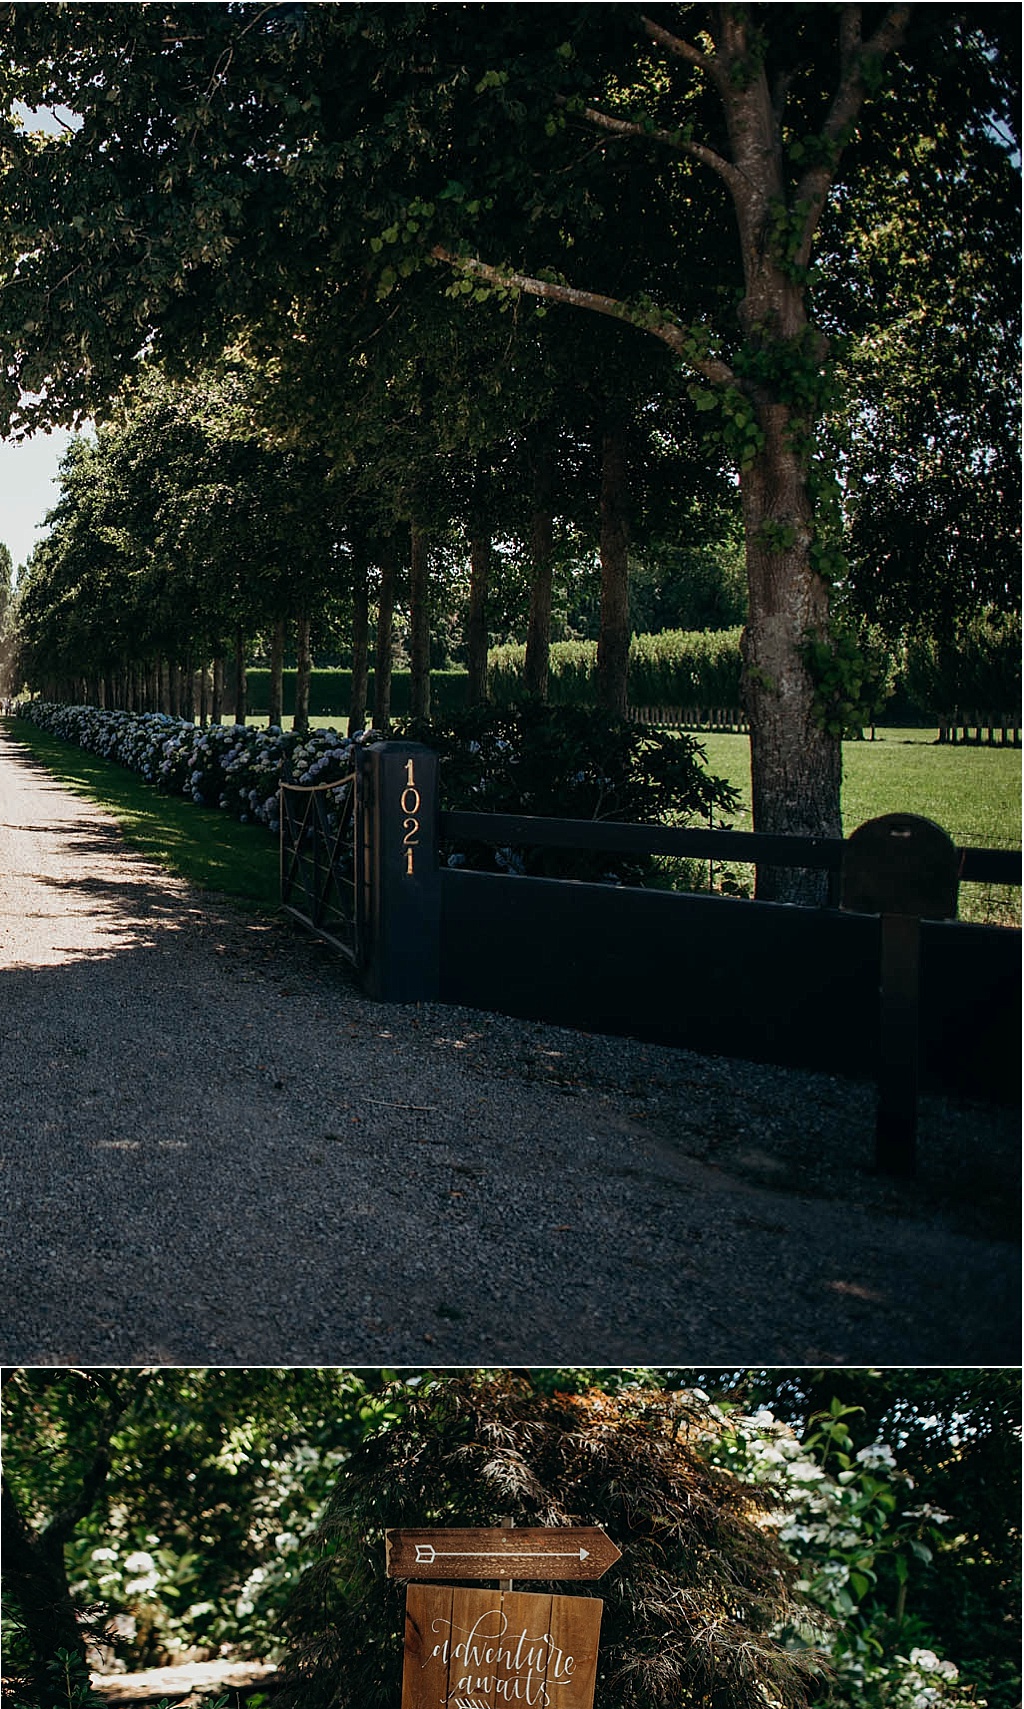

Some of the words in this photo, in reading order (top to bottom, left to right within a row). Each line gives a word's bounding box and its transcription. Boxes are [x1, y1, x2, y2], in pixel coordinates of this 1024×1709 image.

[401, 759, 420, 875] 1021
[422, 1610, 576, 1678] adventure
[440, 1668, 571, 1707] awaits
